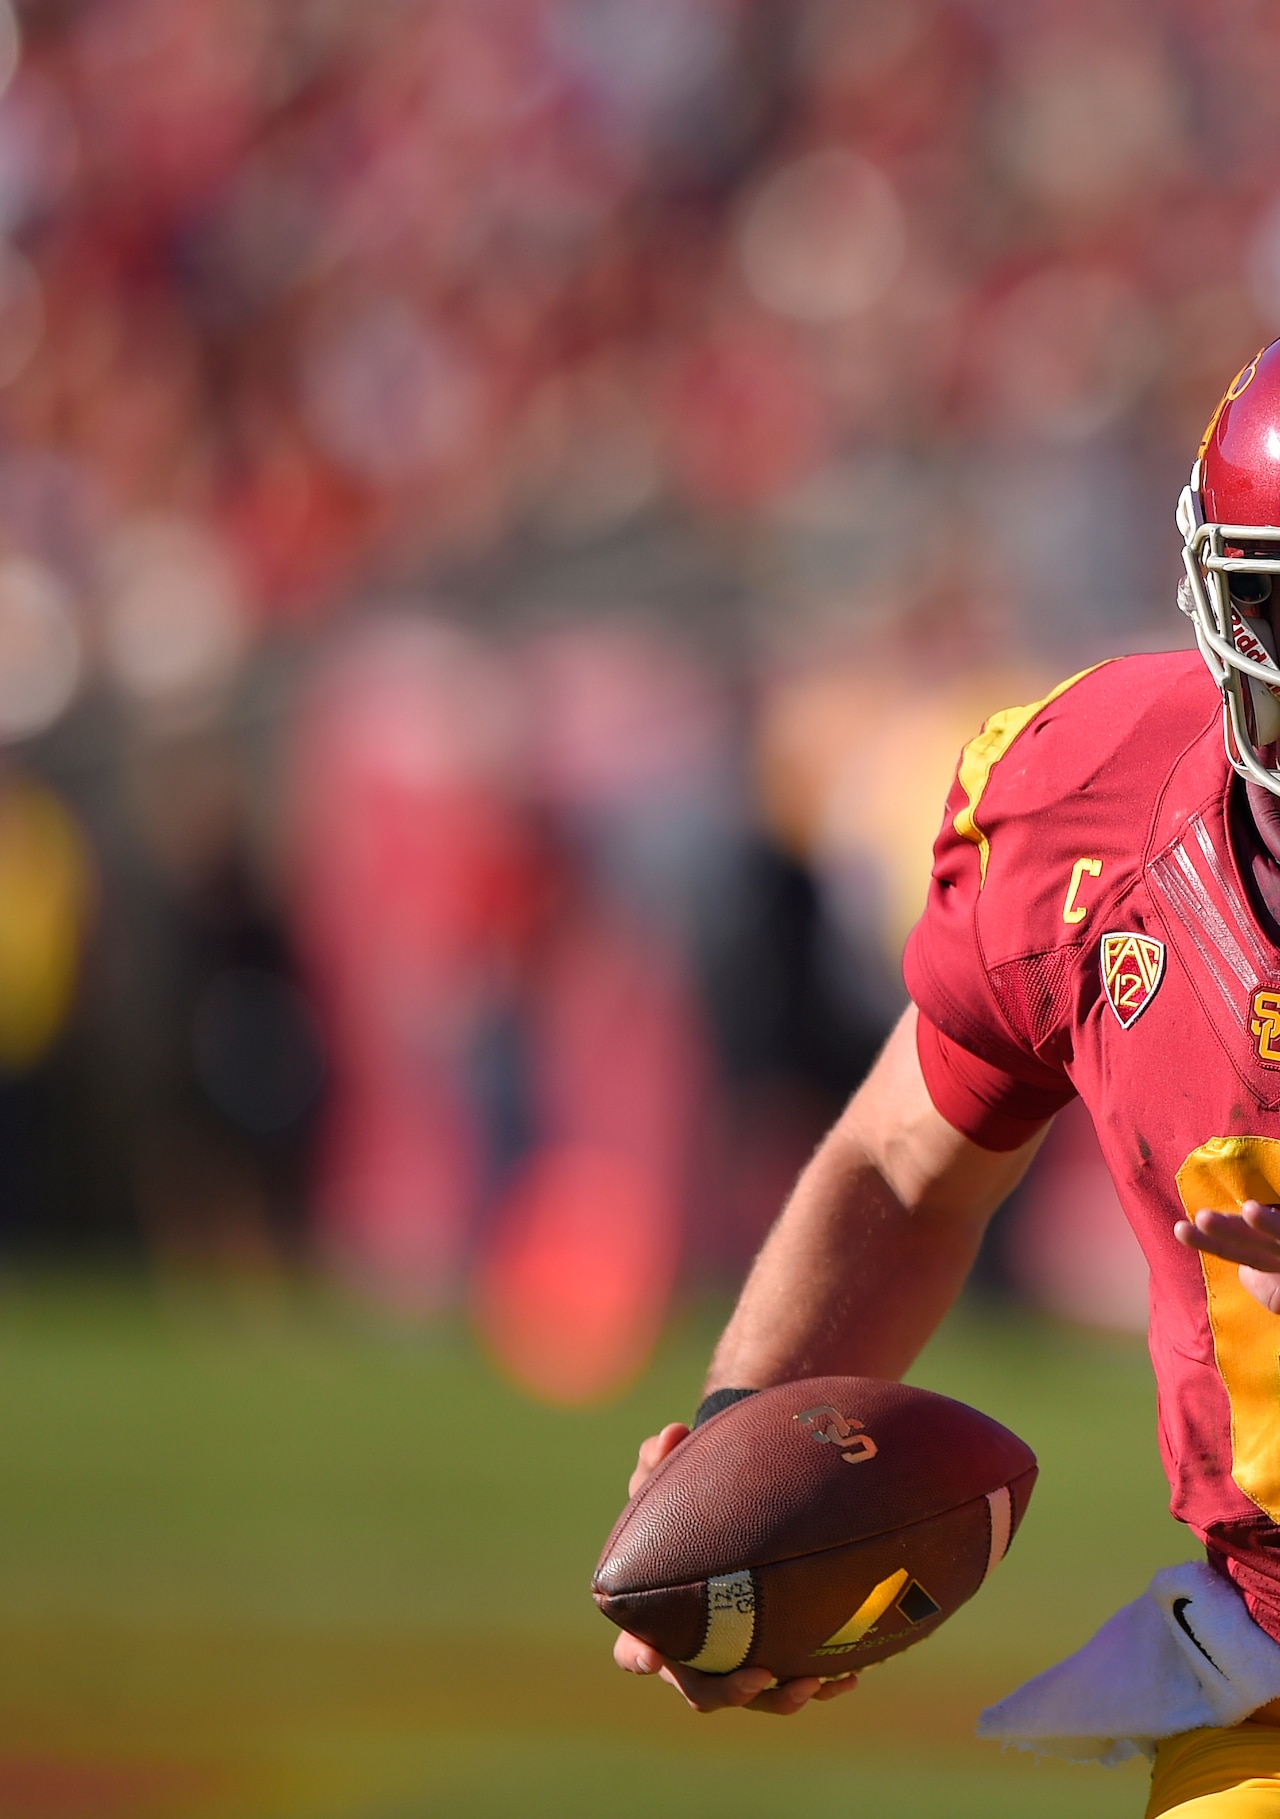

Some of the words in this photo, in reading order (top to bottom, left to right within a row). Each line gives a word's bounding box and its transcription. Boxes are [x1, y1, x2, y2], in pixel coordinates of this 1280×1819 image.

[1062, 857, 1103, 924] C
[1104, 937, 1161, 994] PAC
[1113, 973, 1142, 1007] 12
